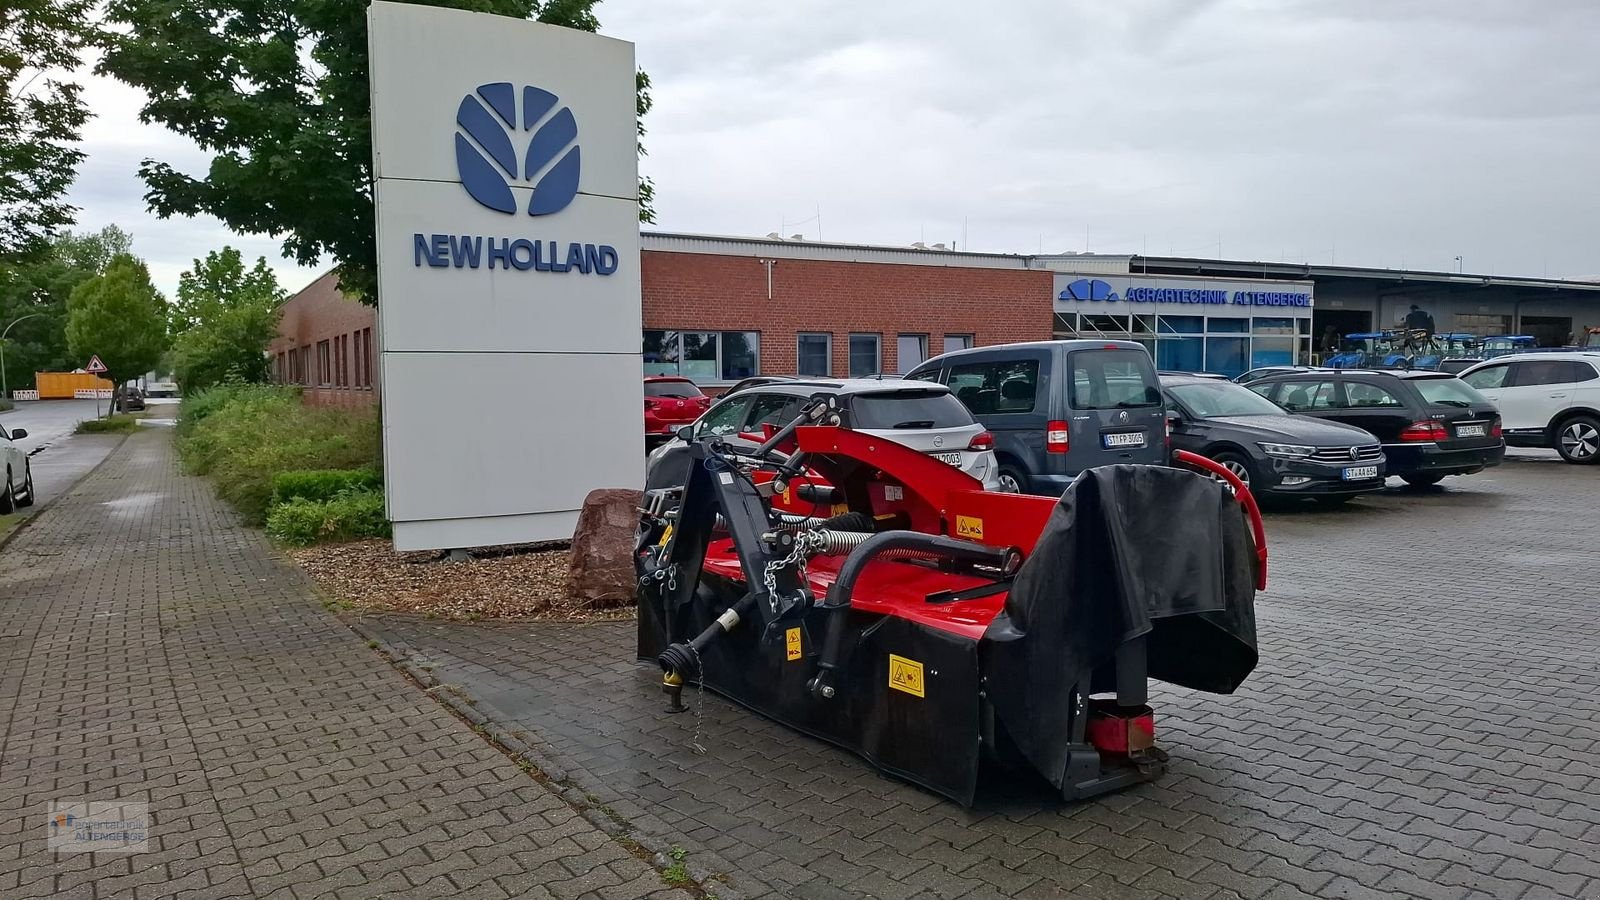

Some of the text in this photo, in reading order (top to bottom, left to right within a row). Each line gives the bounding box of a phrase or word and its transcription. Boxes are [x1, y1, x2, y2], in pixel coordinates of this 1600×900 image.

[413, 233, 619, 276] NEW HOLLAND
[1125, 287, 1312, 307] AGRARTECHNIK ALTENBERGE
